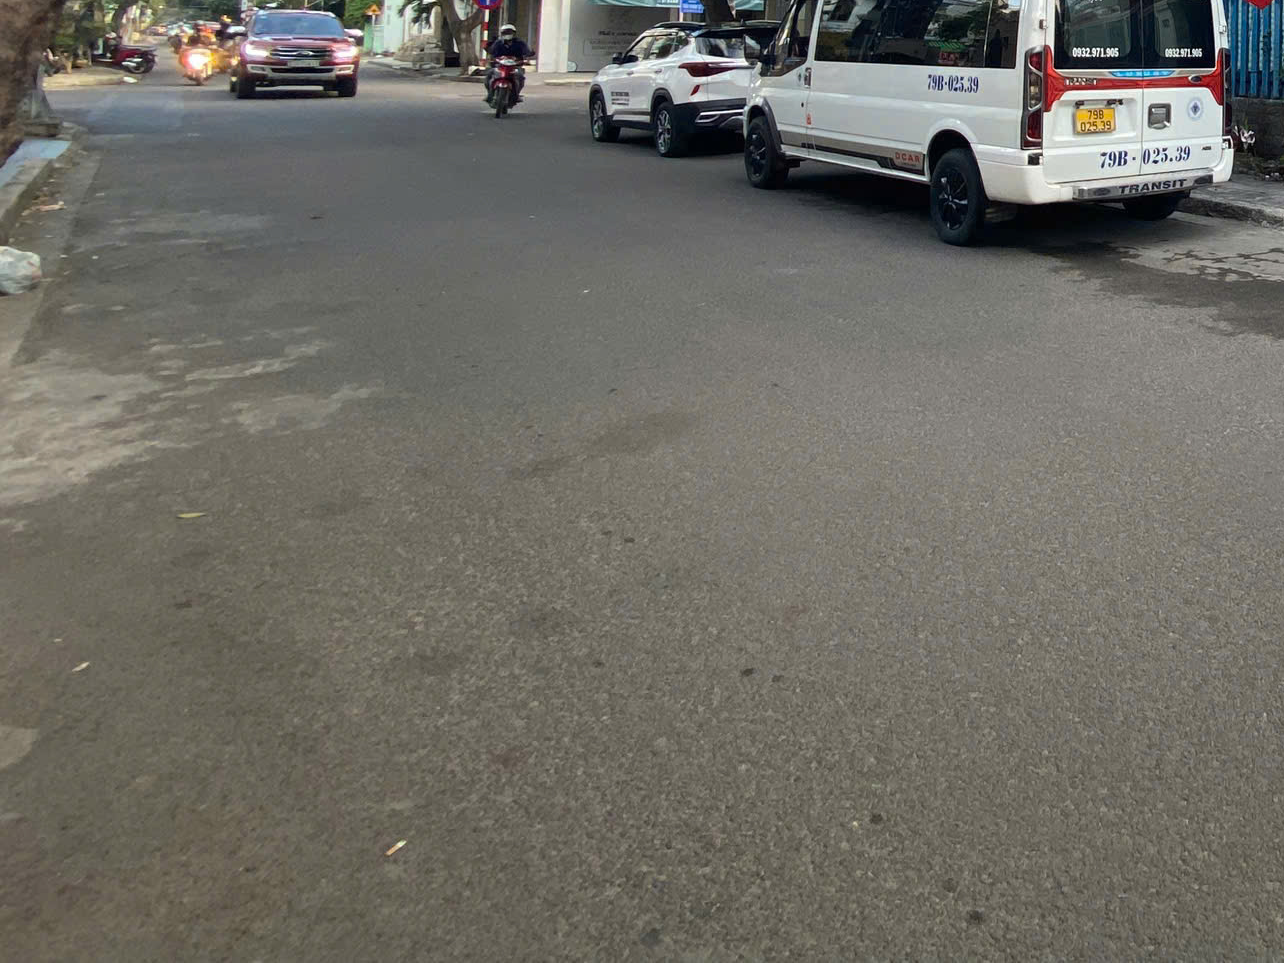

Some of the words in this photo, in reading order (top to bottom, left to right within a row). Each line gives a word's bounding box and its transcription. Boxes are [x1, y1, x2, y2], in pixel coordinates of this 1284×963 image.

[1072, 47, 1119, 58] 0932.971.905
[1165, 48, 1203, 58] 0932.971.905
[1088, 109, 1104, 120] 79B
[895, 151, 921, 163] DCAR
[1100, 150, 1128, 169] 79B
[1142, 145, 1191, 165] 025.39
[1119, 179, 1187, 195] TRANSIT
